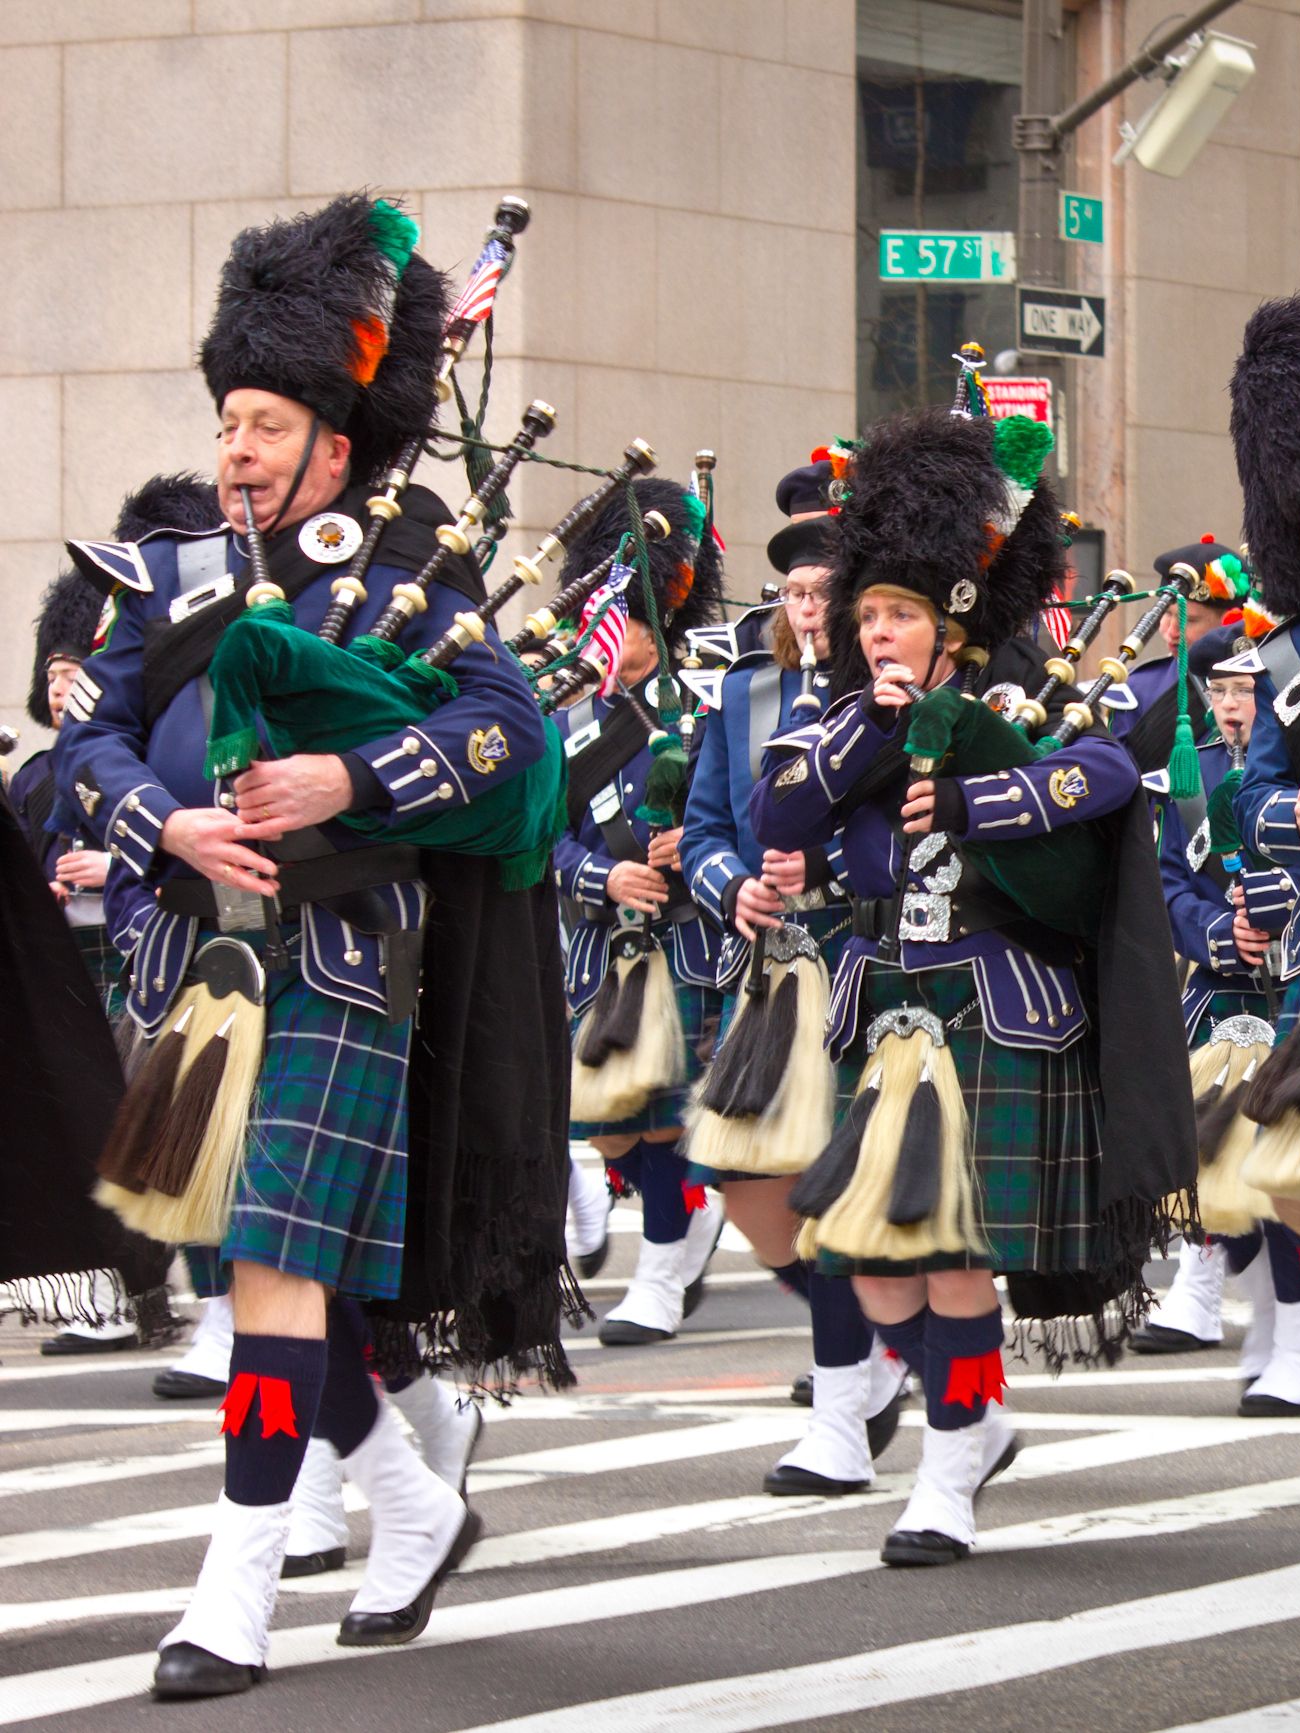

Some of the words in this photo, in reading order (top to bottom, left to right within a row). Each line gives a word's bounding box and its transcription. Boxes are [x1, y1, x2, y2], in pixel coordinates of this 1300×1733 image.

[1069, 199, 1080, 235] 5
[886, 238, 905, 275] E
[917, 239, 958, 275] 57
[963, 239, 982, 259] ST
[1030, 307, 1057, 334] ONE
[1068, 313, 1093, 335] WAY
[987, 384, 1047, 403] STANDING
